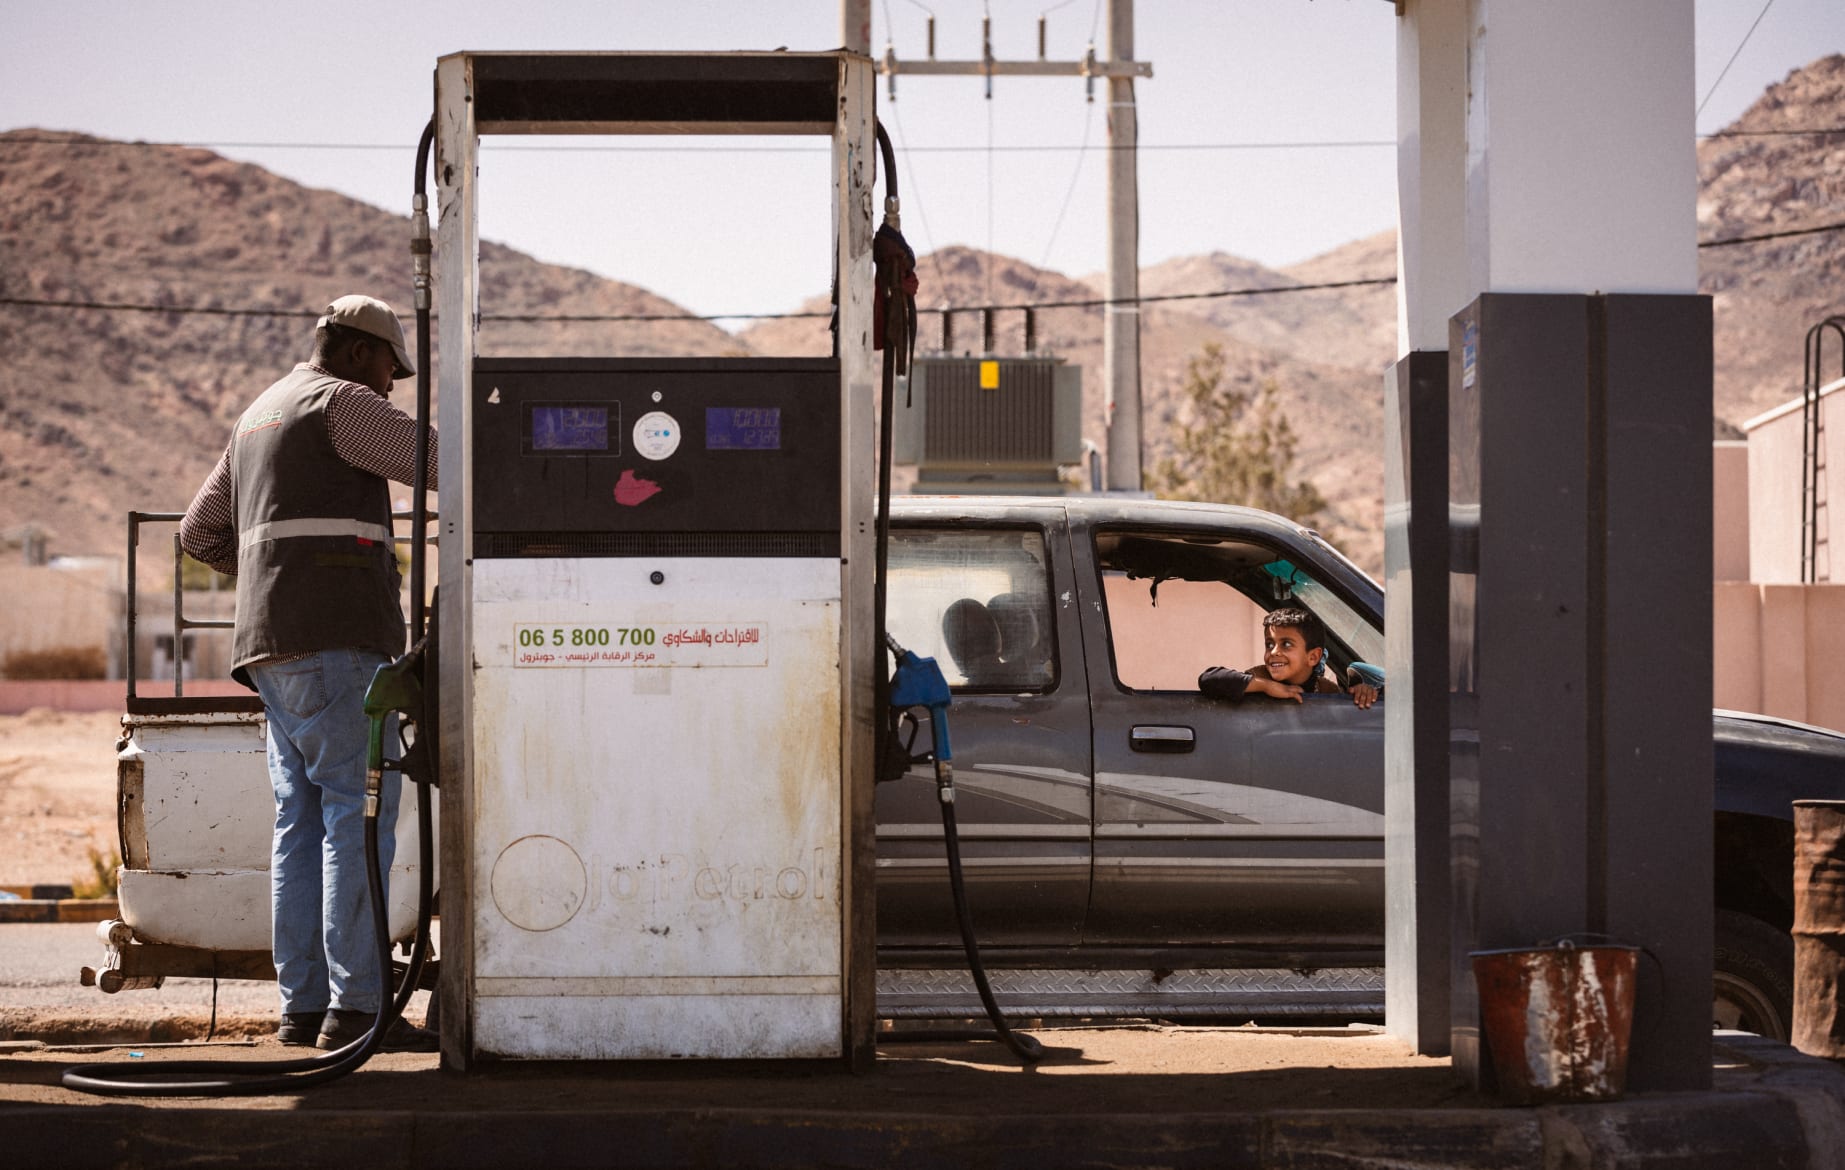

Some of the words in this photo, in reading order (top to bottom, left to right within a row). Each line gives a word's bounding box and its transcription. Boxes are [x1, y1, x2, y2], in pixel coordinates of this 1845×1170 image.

[519, 629, 545, 648] 06
[552, 628, 565, 647] 5
[571, 628, 610, 647] 800
[617, 627, 656, 646] 700
[715, 628, 759, 647] للاقتراحات
[565, 652, 599, 662] الرئيسي
[602, 651, 631, 662] الرقابة
[633, 652, 655, 662] مركز
